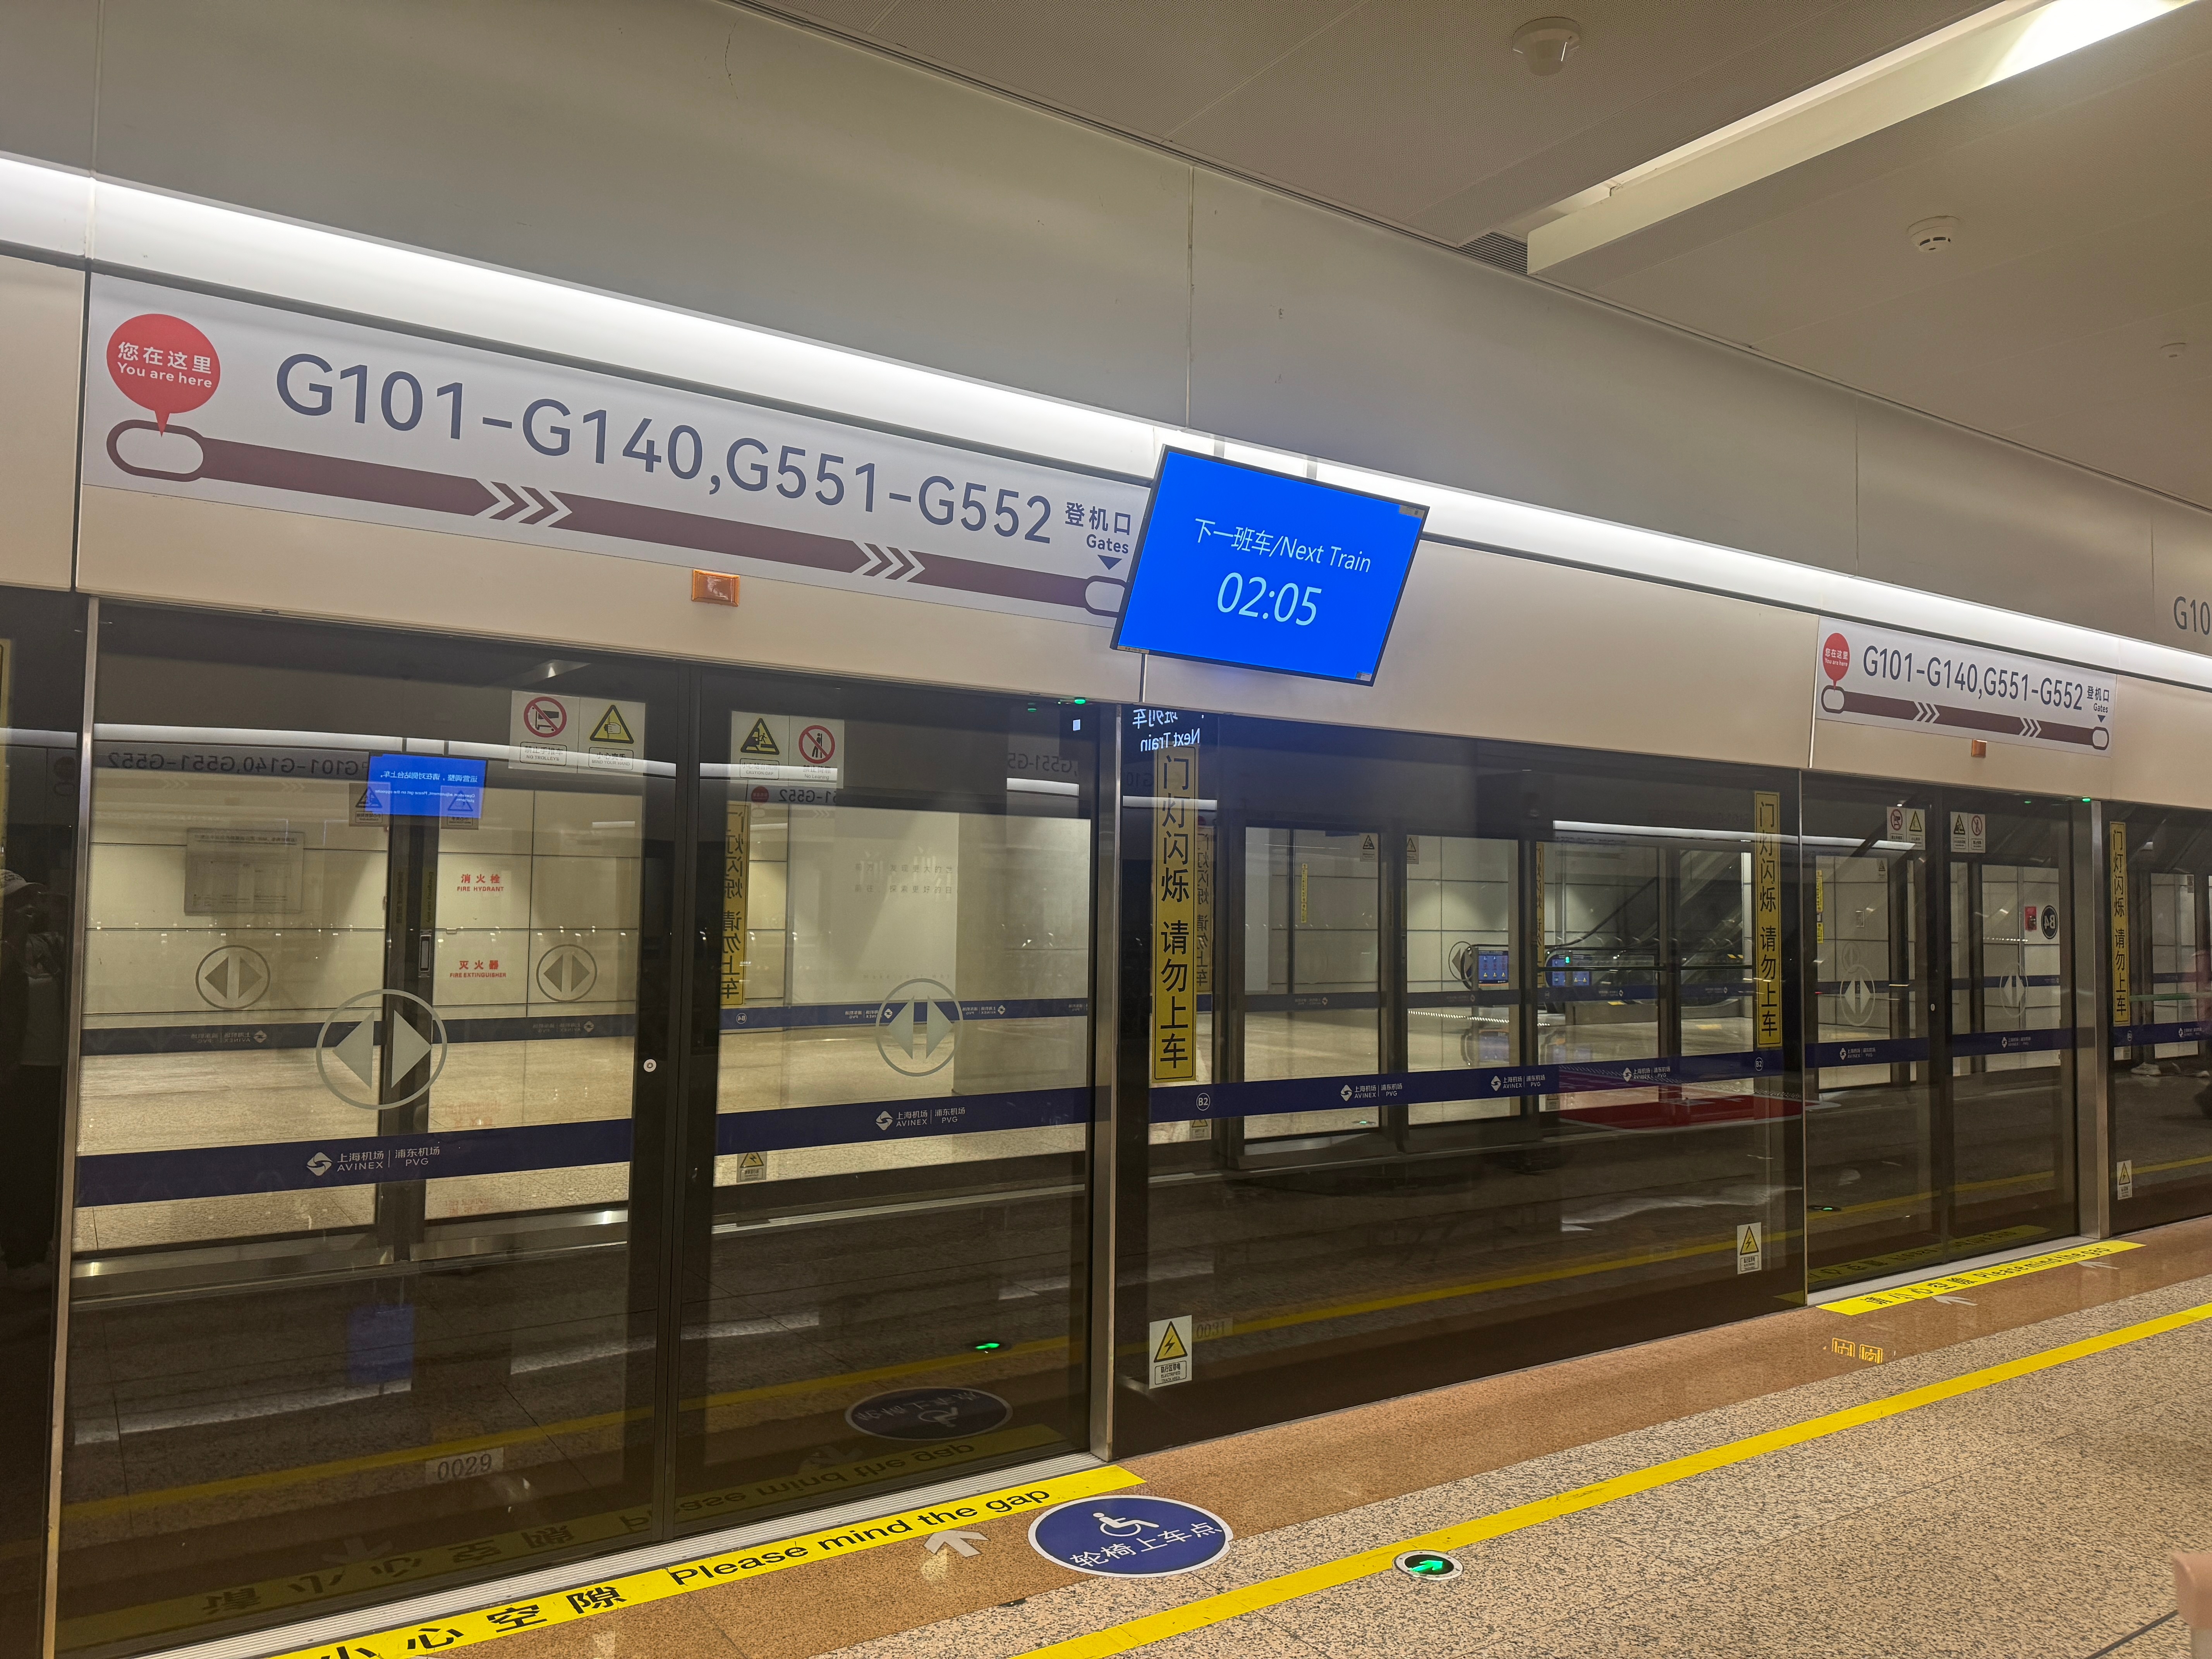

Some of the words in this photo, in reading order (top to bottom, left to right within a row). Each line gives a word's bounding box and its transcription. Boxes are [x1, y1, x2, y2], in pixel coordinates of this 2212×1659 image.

[118, 342, 211, 374] 您在这里
[117, 362, 145, 377] You
[150, 371, 174, 381] are
[179, 372, 212, 388] here
[276, 353, 1051, 544] G101-G140,G551-G552
[1065, 502, 1132, 536] 登机口
[1086, 534, 1129, 555] Gates
[1195, 517, 1324, 564] 下一班车/Next
[1329, 547, 1371, 573] Train
[1217, 572, 1322, 626] 02:05
[2173, 596, 2210, 635] G10
[1825, 648, 1848, 660] 您在这里
[1863, 645, 2083, 711] G101-G140,G551-G552
[2087, 686, 2110, 702] 登机口
[2093, 703, 2109, 713] Gates
[524, 746, 563, 754] 禁止手推车
[596, 752, 626, 761] 小心夹手
[1161, 755, 1190, 903] 门灯闪烁
[1759, 801, 1776, 913] 门灯闪烁
[461, 874, 500, 883] 消火栓
[2113, 830, 2124, 917] 门灯闪烁
[459, 960, 499, 970] 灭火器
[2114, 928, 2126, 1017] 请勿上车
[1159, 919, 1189, 1070] 请勿上车
[1760, 926, 1778, 1037] 请勿上车
[896, 1110, 927, 1120] 上海机场
[935, 1107, 965, 1117] 浦东机场
[1198, 1097, 1208, 1106] B2
[896, 1119, 927, 1127] AVINEX
[337, 1161, 383, 1172] AVINEX
[405, 1158, 429, 1166] PVG
[338, 1150, 384, 1163] 上海机场
[395, 1146, 440, 1159] 浦东机场
[1973, 1265, 2022, 1279] Please
[2022, 1256, 2059, 1269] mind
[2056, 1251, 2081, 1262] the
[2081, 1246, 2112, 1258] gap
[436, 1453, 494, 1481] 0029
[670, 1541, 809, 1586] Please
[817, 1518, 914, 1553] mind
[917, 1502, 977, 1532] the
[986, 1488, 1050, 1513] gap
[1069, 1521, 1222, 1569] 轮椅上车点
